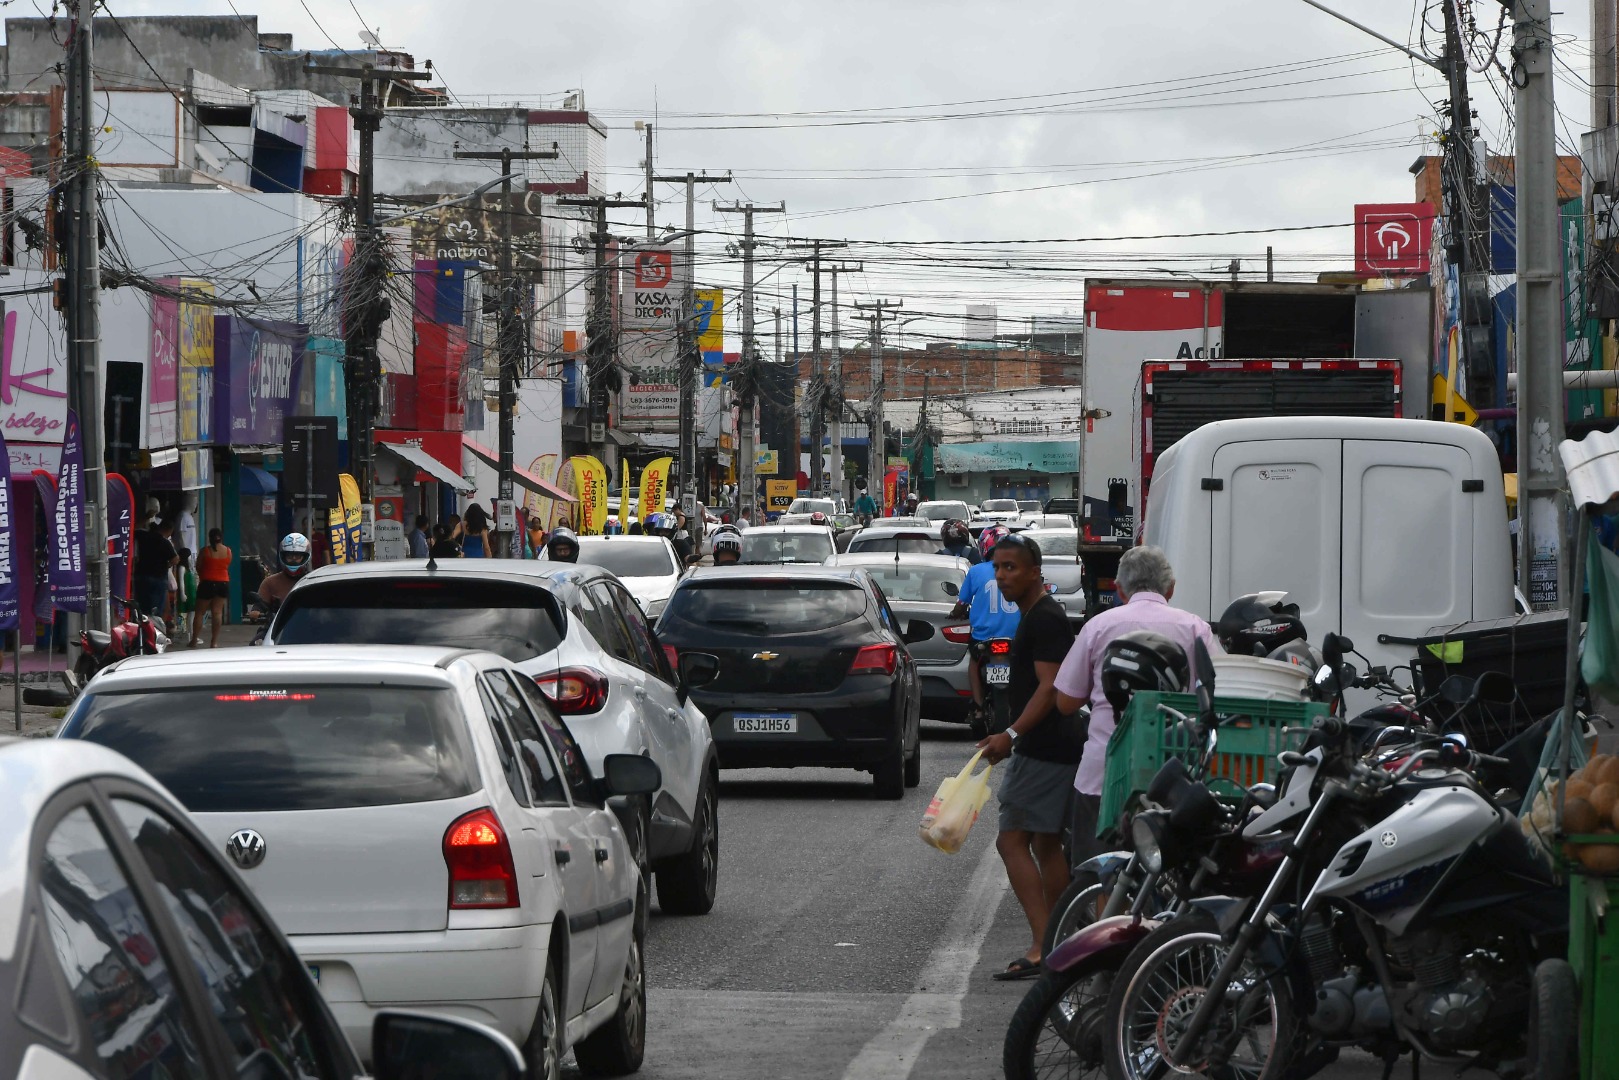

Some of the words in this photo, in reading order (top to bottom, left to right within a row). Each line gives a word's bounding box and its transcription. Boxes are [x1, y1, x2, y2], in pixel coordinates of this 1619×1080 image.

[437, 246, 488, 259] natura
[635, 292, 671, 305] KASA
[635, 307, 672, 319] DECOR
[260, 342, 293, 399] ESTHER
[70, 463, 78, 495] BANHO
[653, 479, 663, 506] Mega
[582, 470, 593, 527] Shopping
[590, 480, 598, 508] Mega
[55, 463, 71, 571] DECORAÇÃO
[70, 505, 79, 533] MESA
[72, 543, 81, 572] CAMA
[739, 719, 790, 731] QSJ1H56
